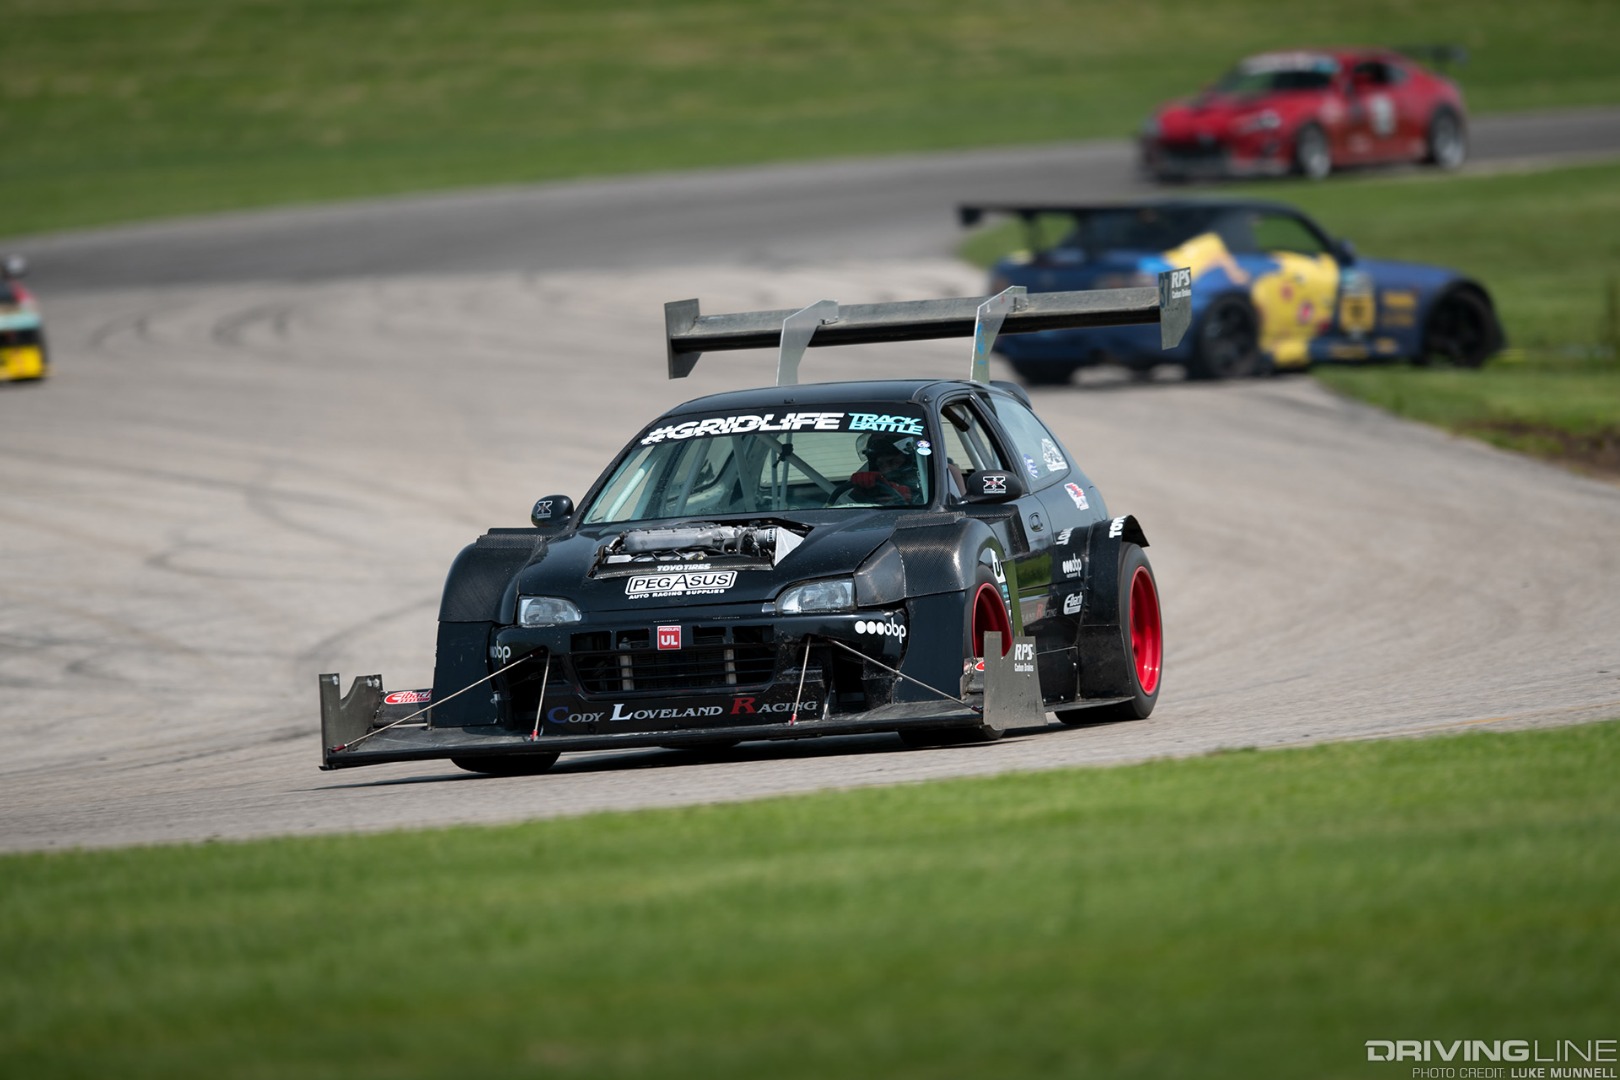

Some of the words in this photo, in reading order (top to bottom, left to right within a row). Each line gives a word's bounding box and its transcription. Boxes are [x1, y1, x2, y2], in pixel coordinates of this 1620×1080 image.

[1171, 269, 1191, 289] RPS
[848, 412, 922, 425] TRACK
[640, 412, 845, 446] #GRIDLIFE
[848, 421, 924, 436] BATTLE
[633, 574, 729, 590] PEGASUS
[660, 635, 678, 646] UL
[1014, 643, 1034, 661] RPS
[547, 706, 604, 724] CODY
[609, 703, 723, 721] LOVELAND
[729, 697, 818, 715] RACING
